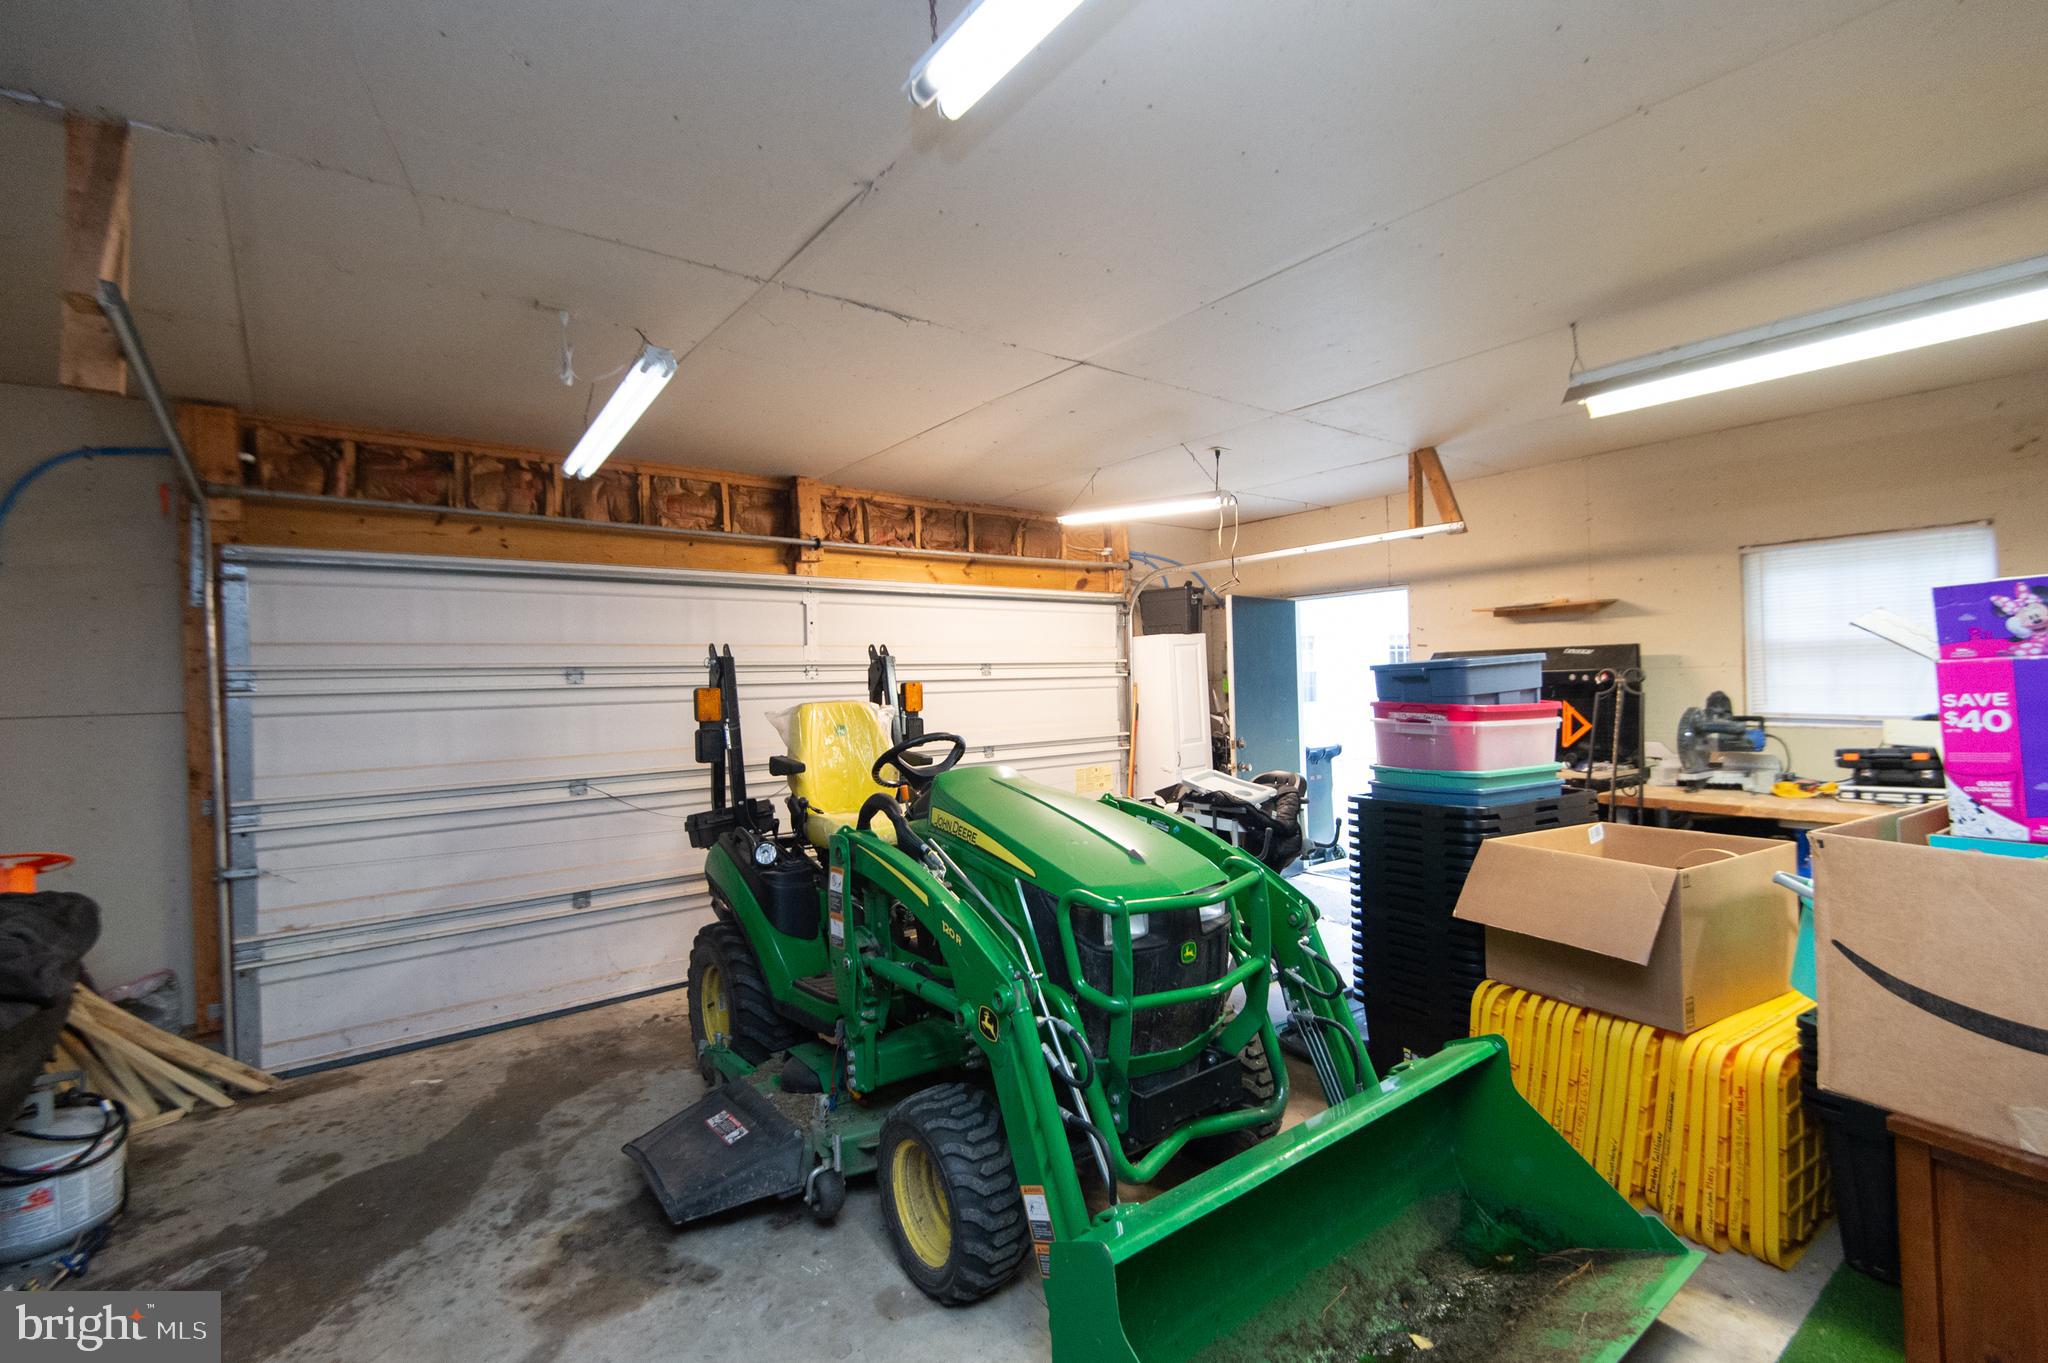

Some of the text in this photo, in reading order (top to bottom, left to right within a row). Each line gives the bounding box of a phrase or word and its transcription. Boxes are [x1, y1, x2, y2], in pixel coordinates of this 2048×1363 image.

[1942, 692, 2010, 707] SAVE
[1943, 709, 2012, 733] $40
[934, 814, 978, 844] JOHN DEERE
